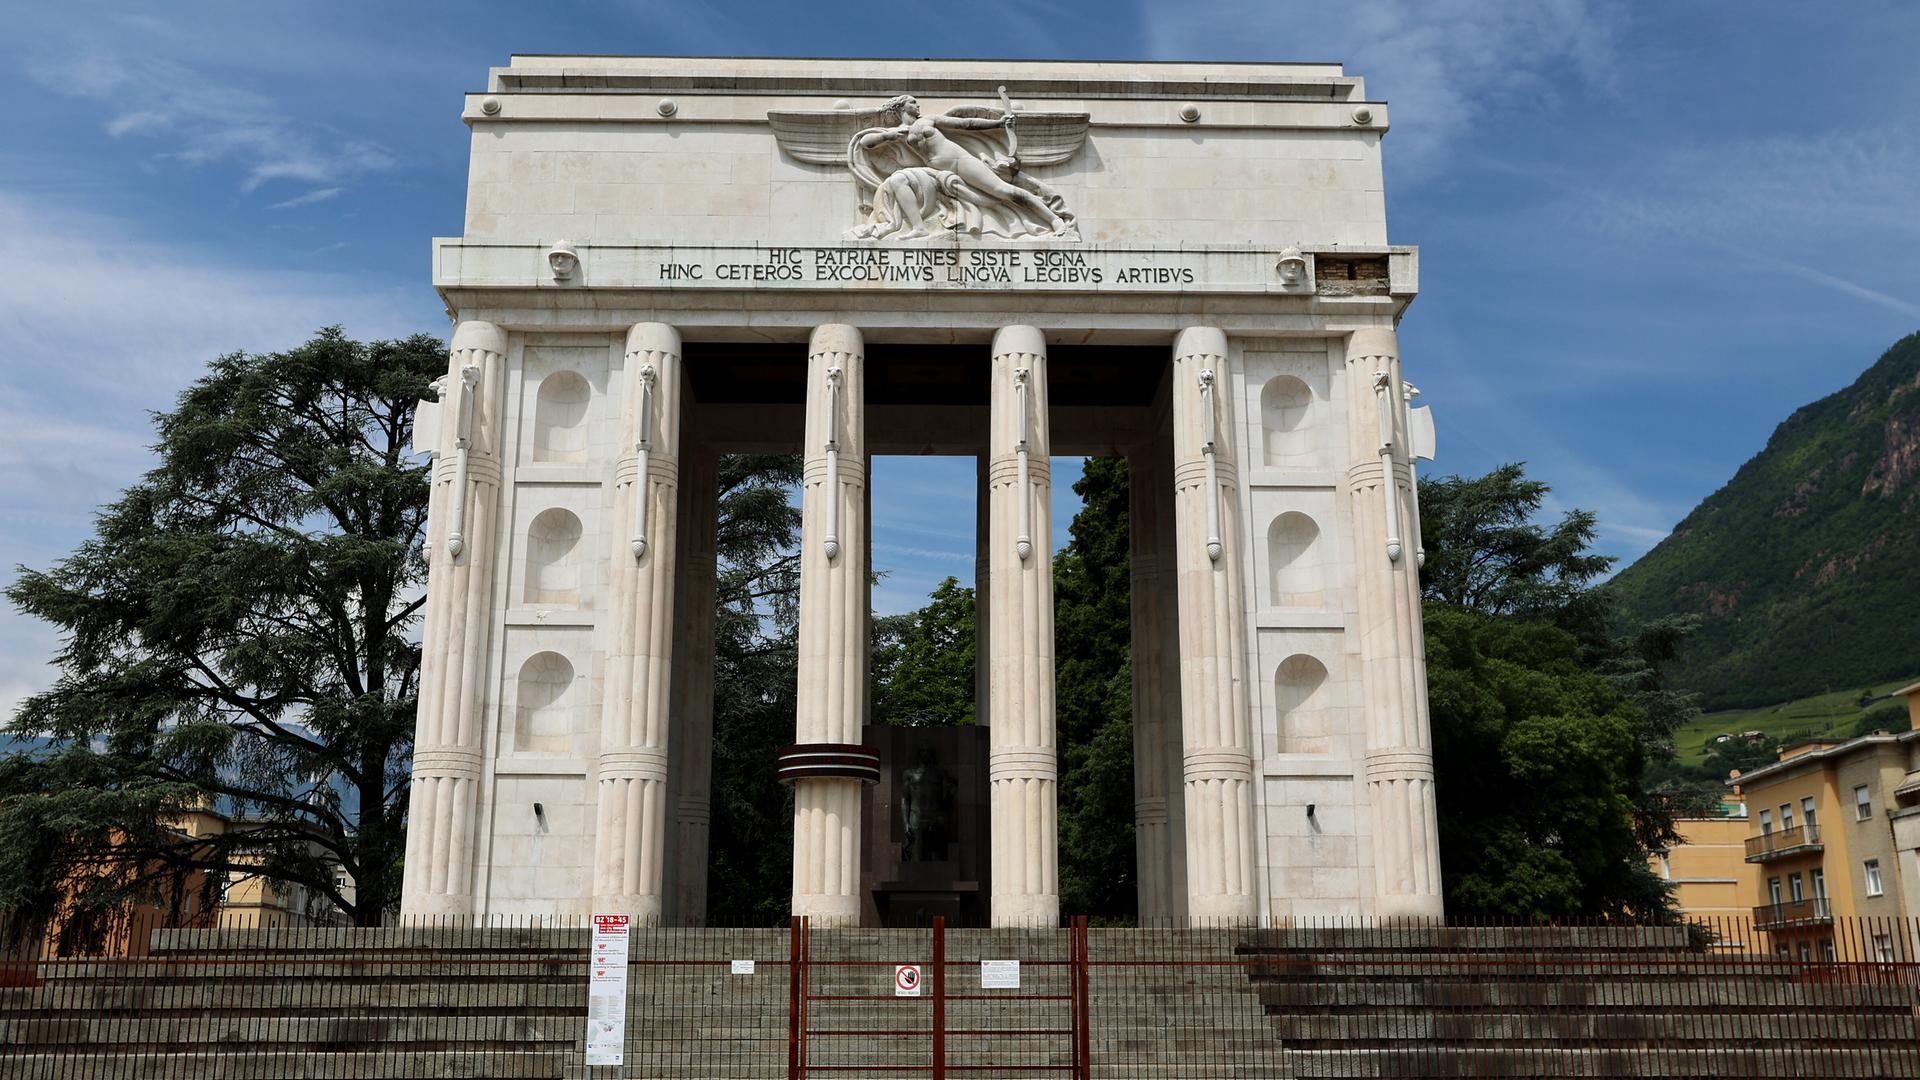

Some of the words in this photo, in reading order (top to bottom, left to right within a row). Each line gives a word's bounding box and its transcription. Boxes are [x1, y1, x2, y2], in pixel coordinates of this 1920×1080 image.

[769, 249, 802, 265] HIC
[815, 250, 890, 265] PATRIAE
[903, 250, 958, 266] FINES
[970, 251, 1021, 267] SISTE
[1033, 251, 1087, 267] SIGNA
[659, 263, 703, 280] HINC
[715, 264, 803, 281] CETEROS
[815, 265, 935, 282] EXCOLVIMVS
[947, 266, 1012, 283] LINGVA
[1024, 267, 1103, 283] LEGIBVS
[1116, 267, 1194, 284] ARTIBVS
